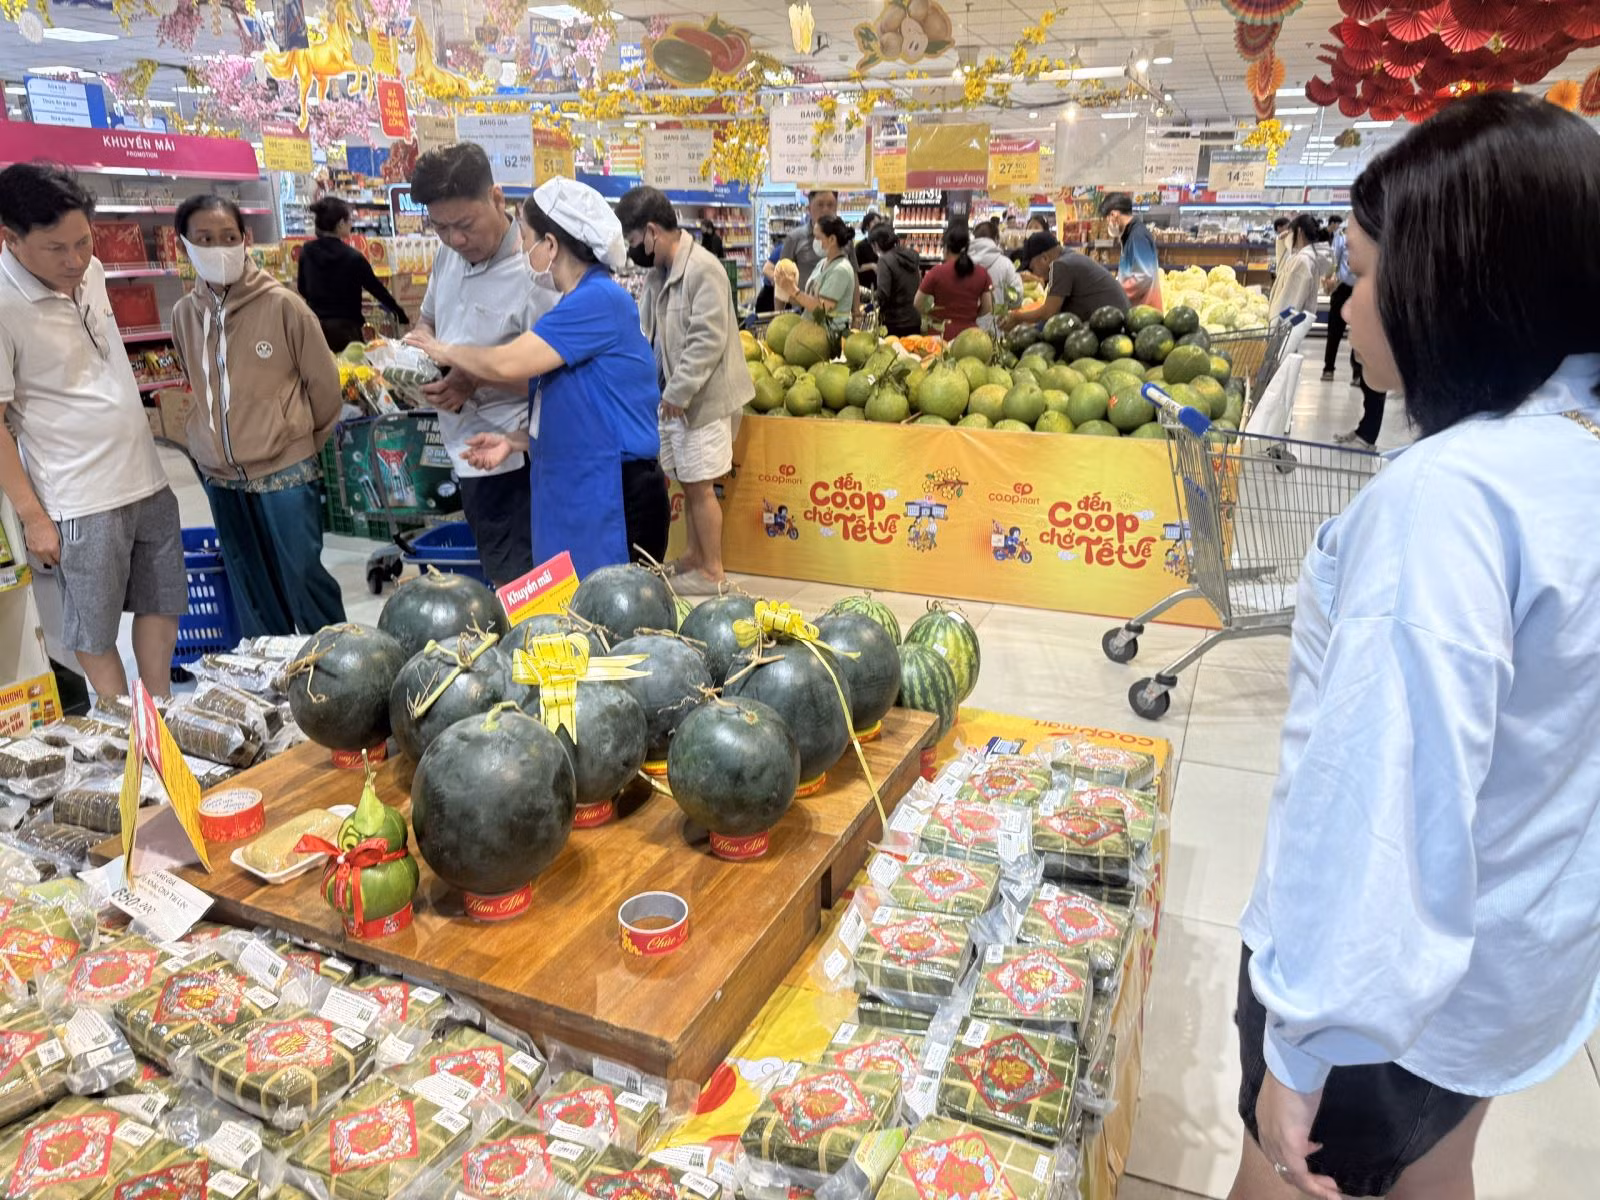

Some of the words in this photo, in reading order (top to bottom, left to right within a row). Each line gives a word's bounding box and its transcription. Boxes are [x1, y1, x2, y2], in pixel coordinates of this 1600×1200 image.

[103, 134, 151, 150] KHUYẾN
[126, 150, 158, 159] PROMOTION
[504, 156, 518, 168] 62
[999, 163, 1013, 174] 27
[1227, 171, 1240, 182] 14
[834, 473, 862, 491] đến
[810, 481, 886, 520] Co.op
[988, 493, 1040, 505] co.opmart
[1077, 491, 1112, 513] đến
[834, 513, 893, 544] Tết
[1048, 501, 1139, 544] Co.op
[1075, 536, 1146, 569] Tết
[1128, 536, 1157, 558] về
[506, 579, 538, 607] Khuyến
